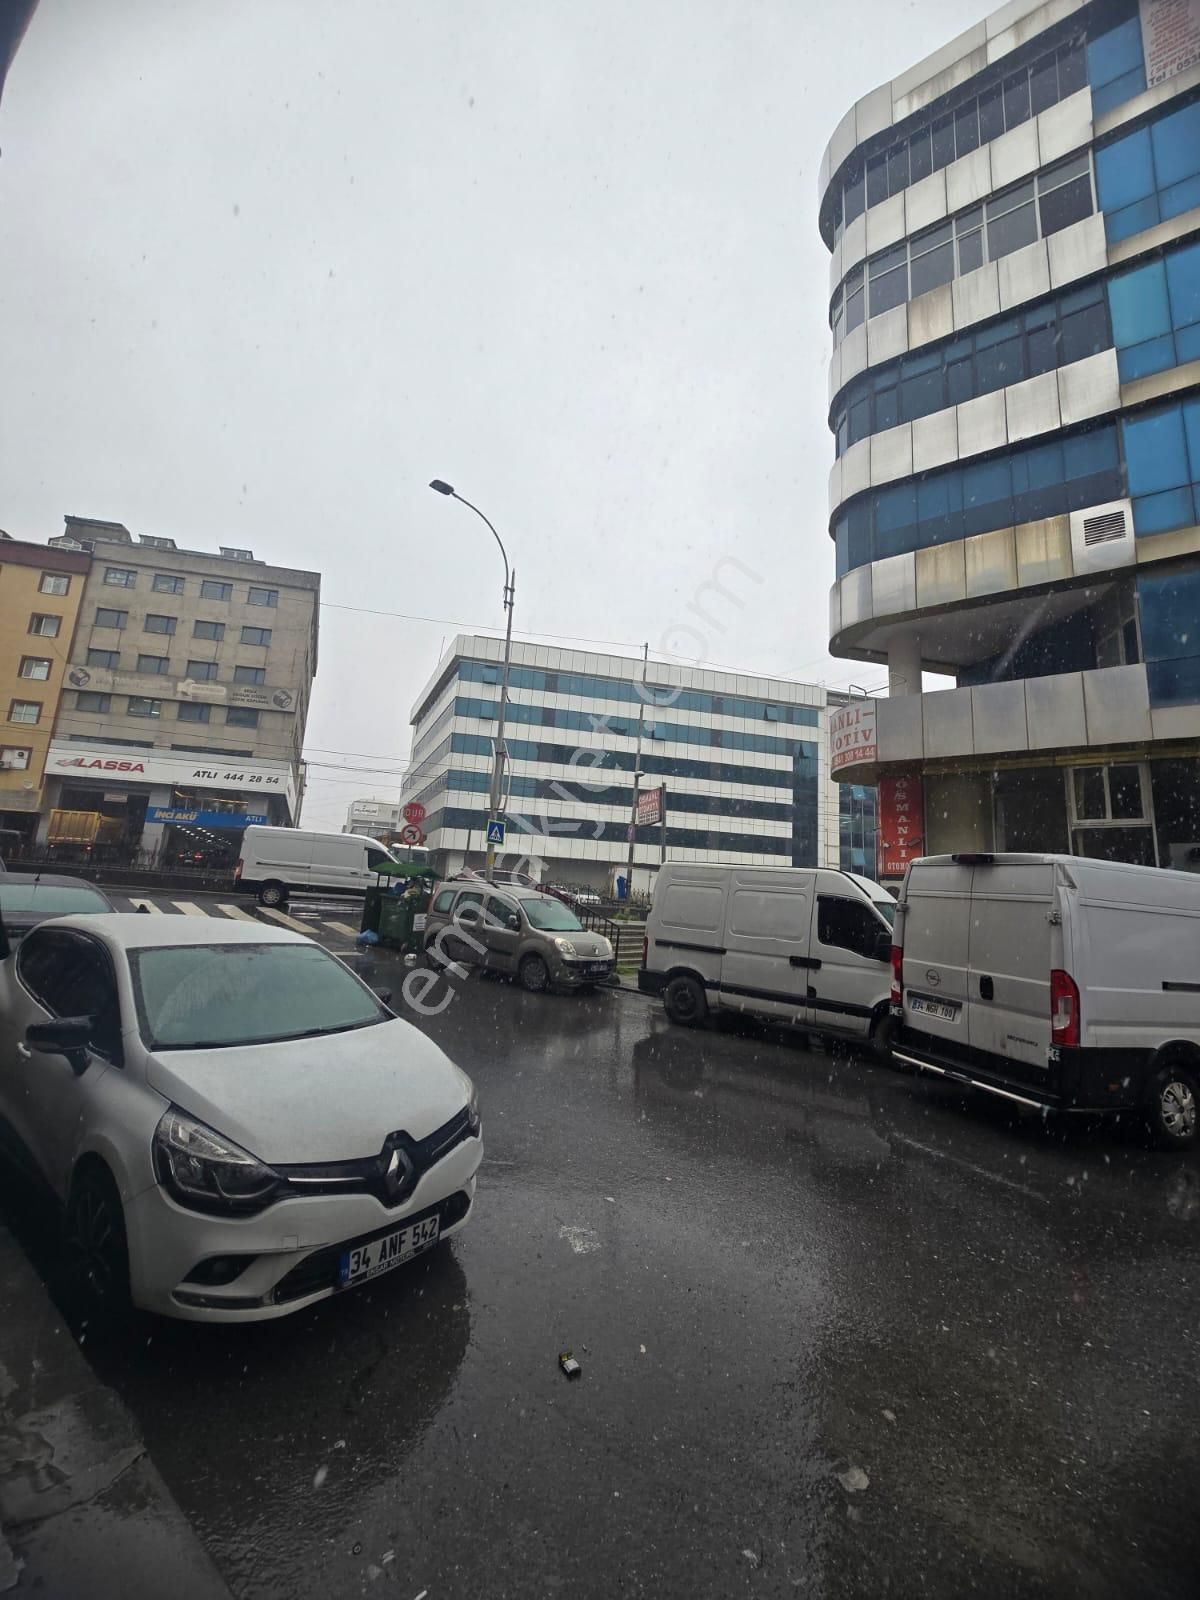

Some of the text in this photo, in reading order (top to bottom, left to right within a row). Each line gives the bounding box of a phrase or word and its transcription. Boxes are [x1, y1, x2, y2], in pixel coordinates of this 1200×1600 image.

[76, 757, 145, 773] LASSA
[192, 770, 280, 785] ATLI 444 28 54
[245, 815, 263, 823] ATLI
[406, 808, 423, 817] DUR
[350, 1247, 371, 1276] 34
[378, 1231, 407, 1263] ANF
[411, 1218, 438, 1247] 542
